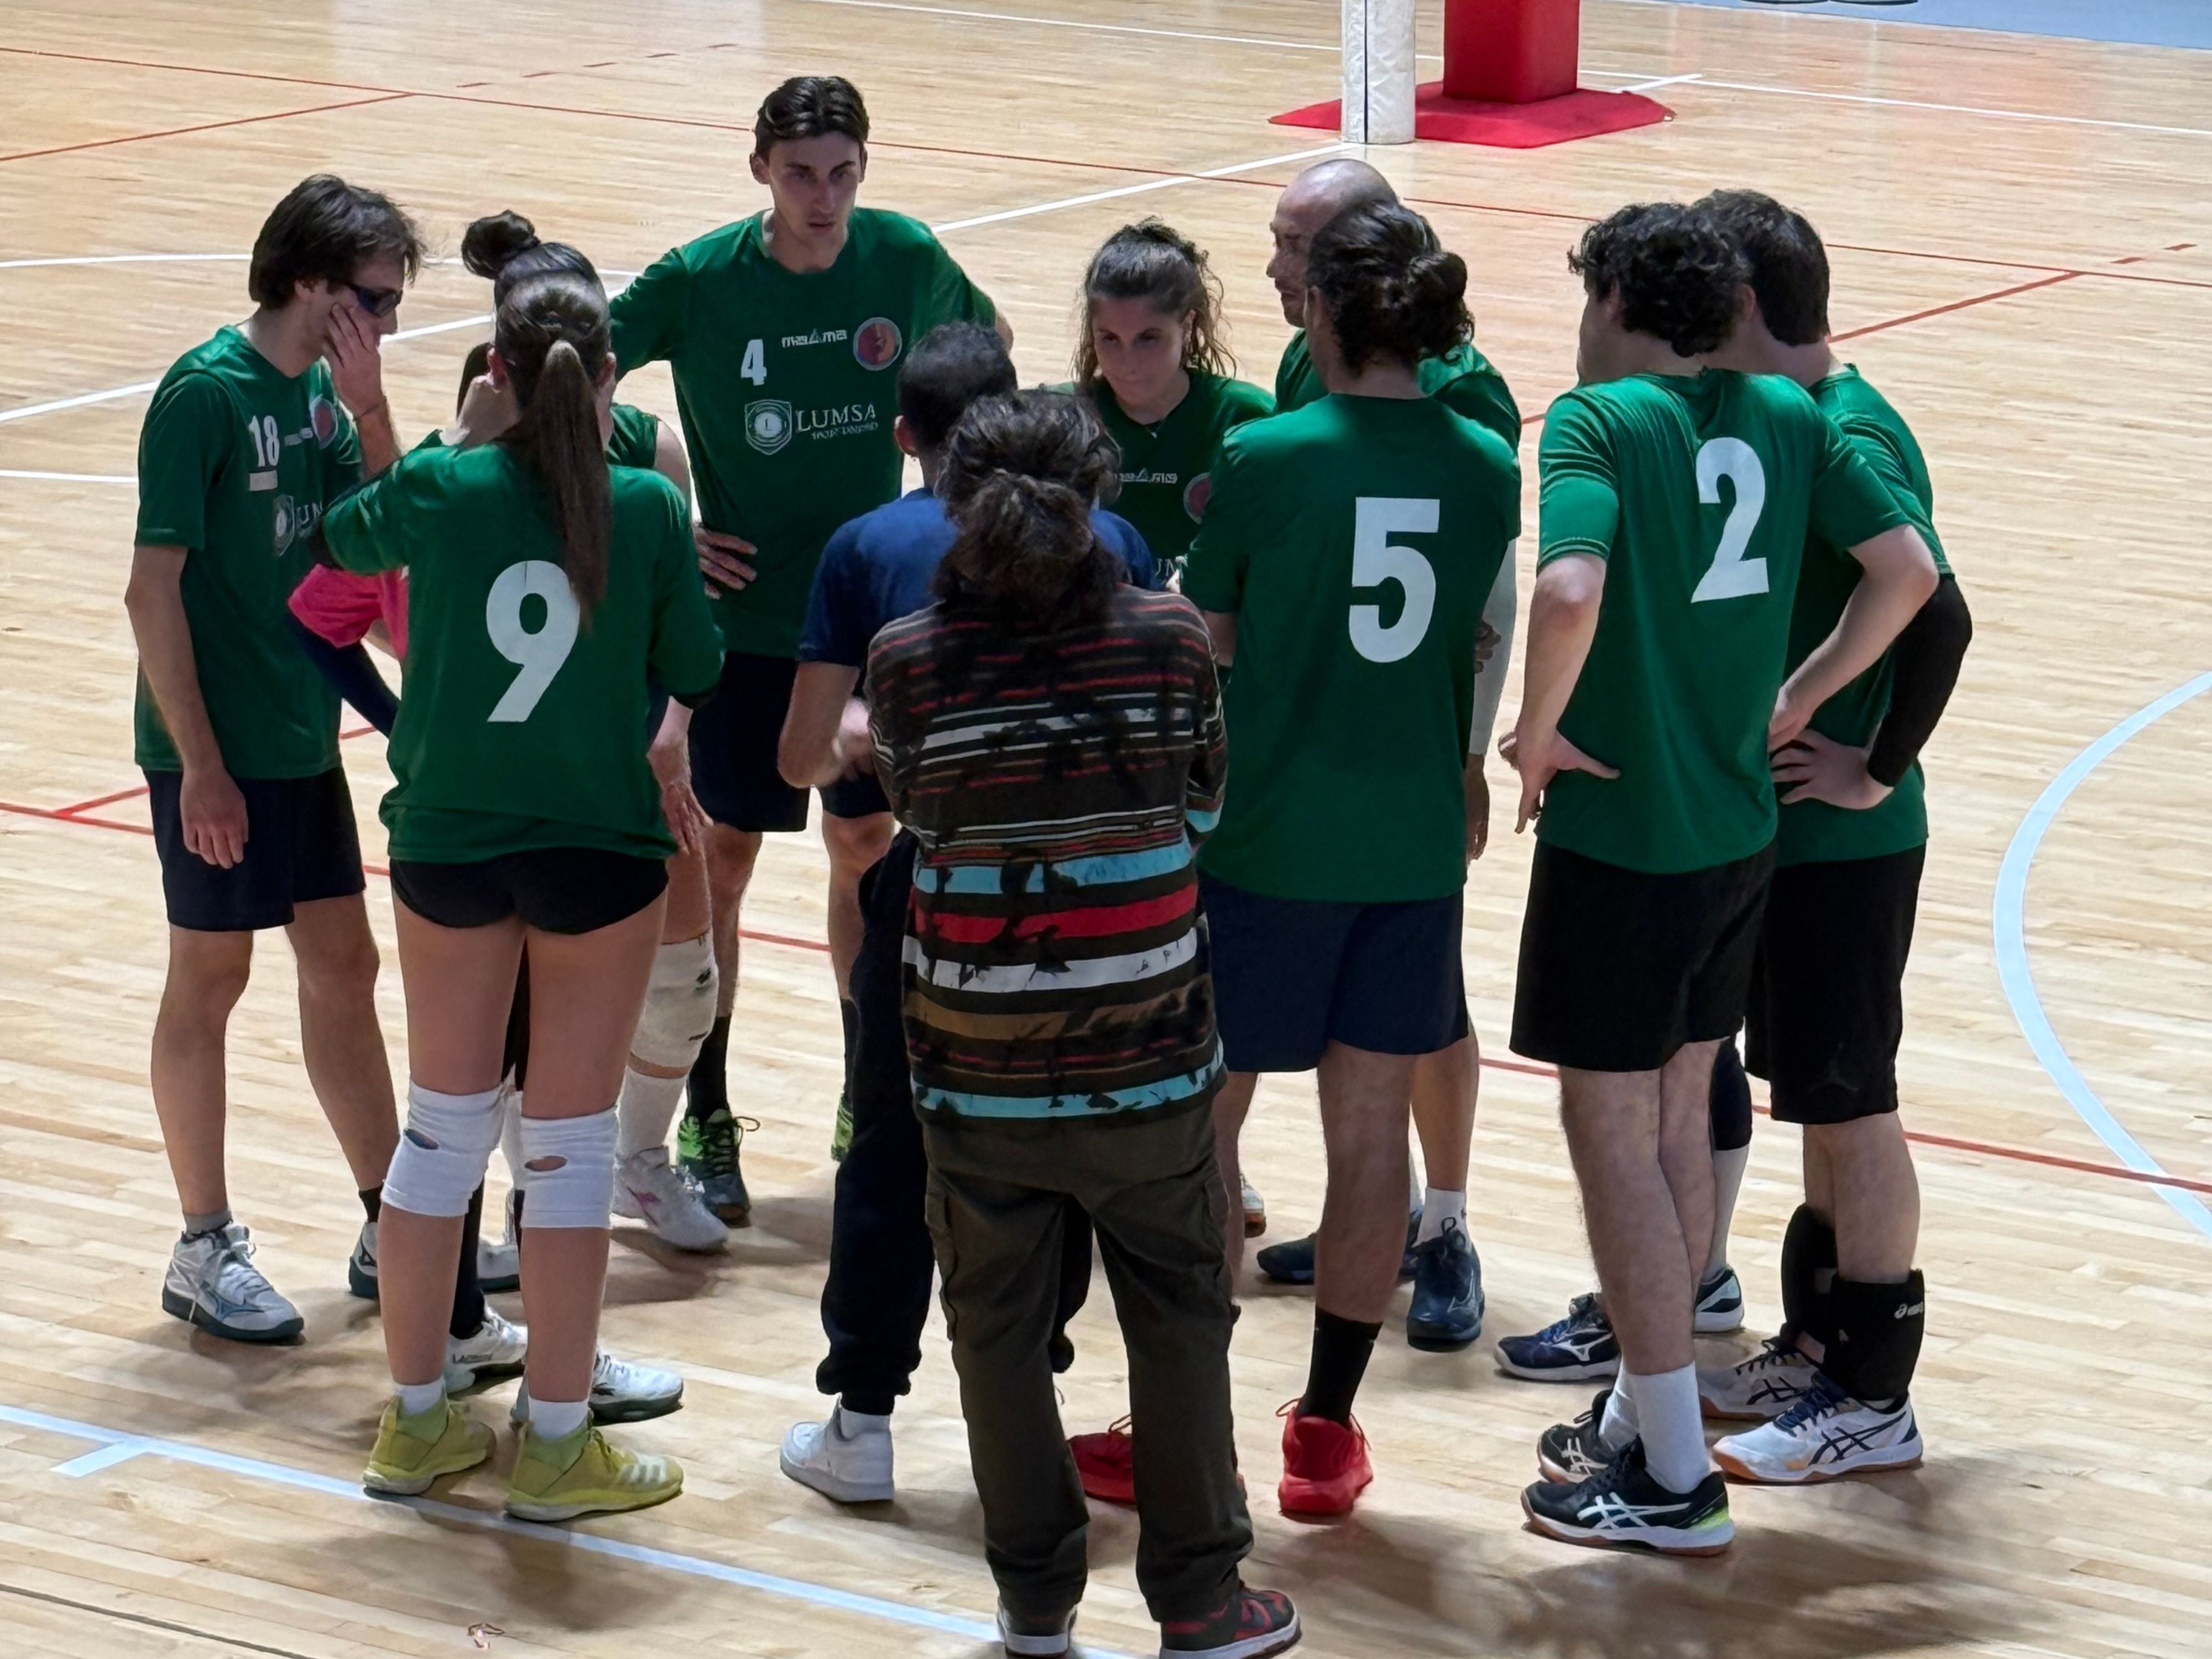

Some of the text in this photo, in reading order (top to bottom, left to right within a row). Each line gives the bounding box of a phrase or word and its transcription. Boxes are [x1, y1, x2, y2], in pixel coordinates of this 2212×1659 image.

[740, 338, 767, 385] 4
[249, 415, 280, 467] 18
[795, 403, 877, 433] LUMSA
[1691, 437, 1770, 603] 2
[1348, 497, 1440, 663] 5
[486, 560, 581, 722] 9
